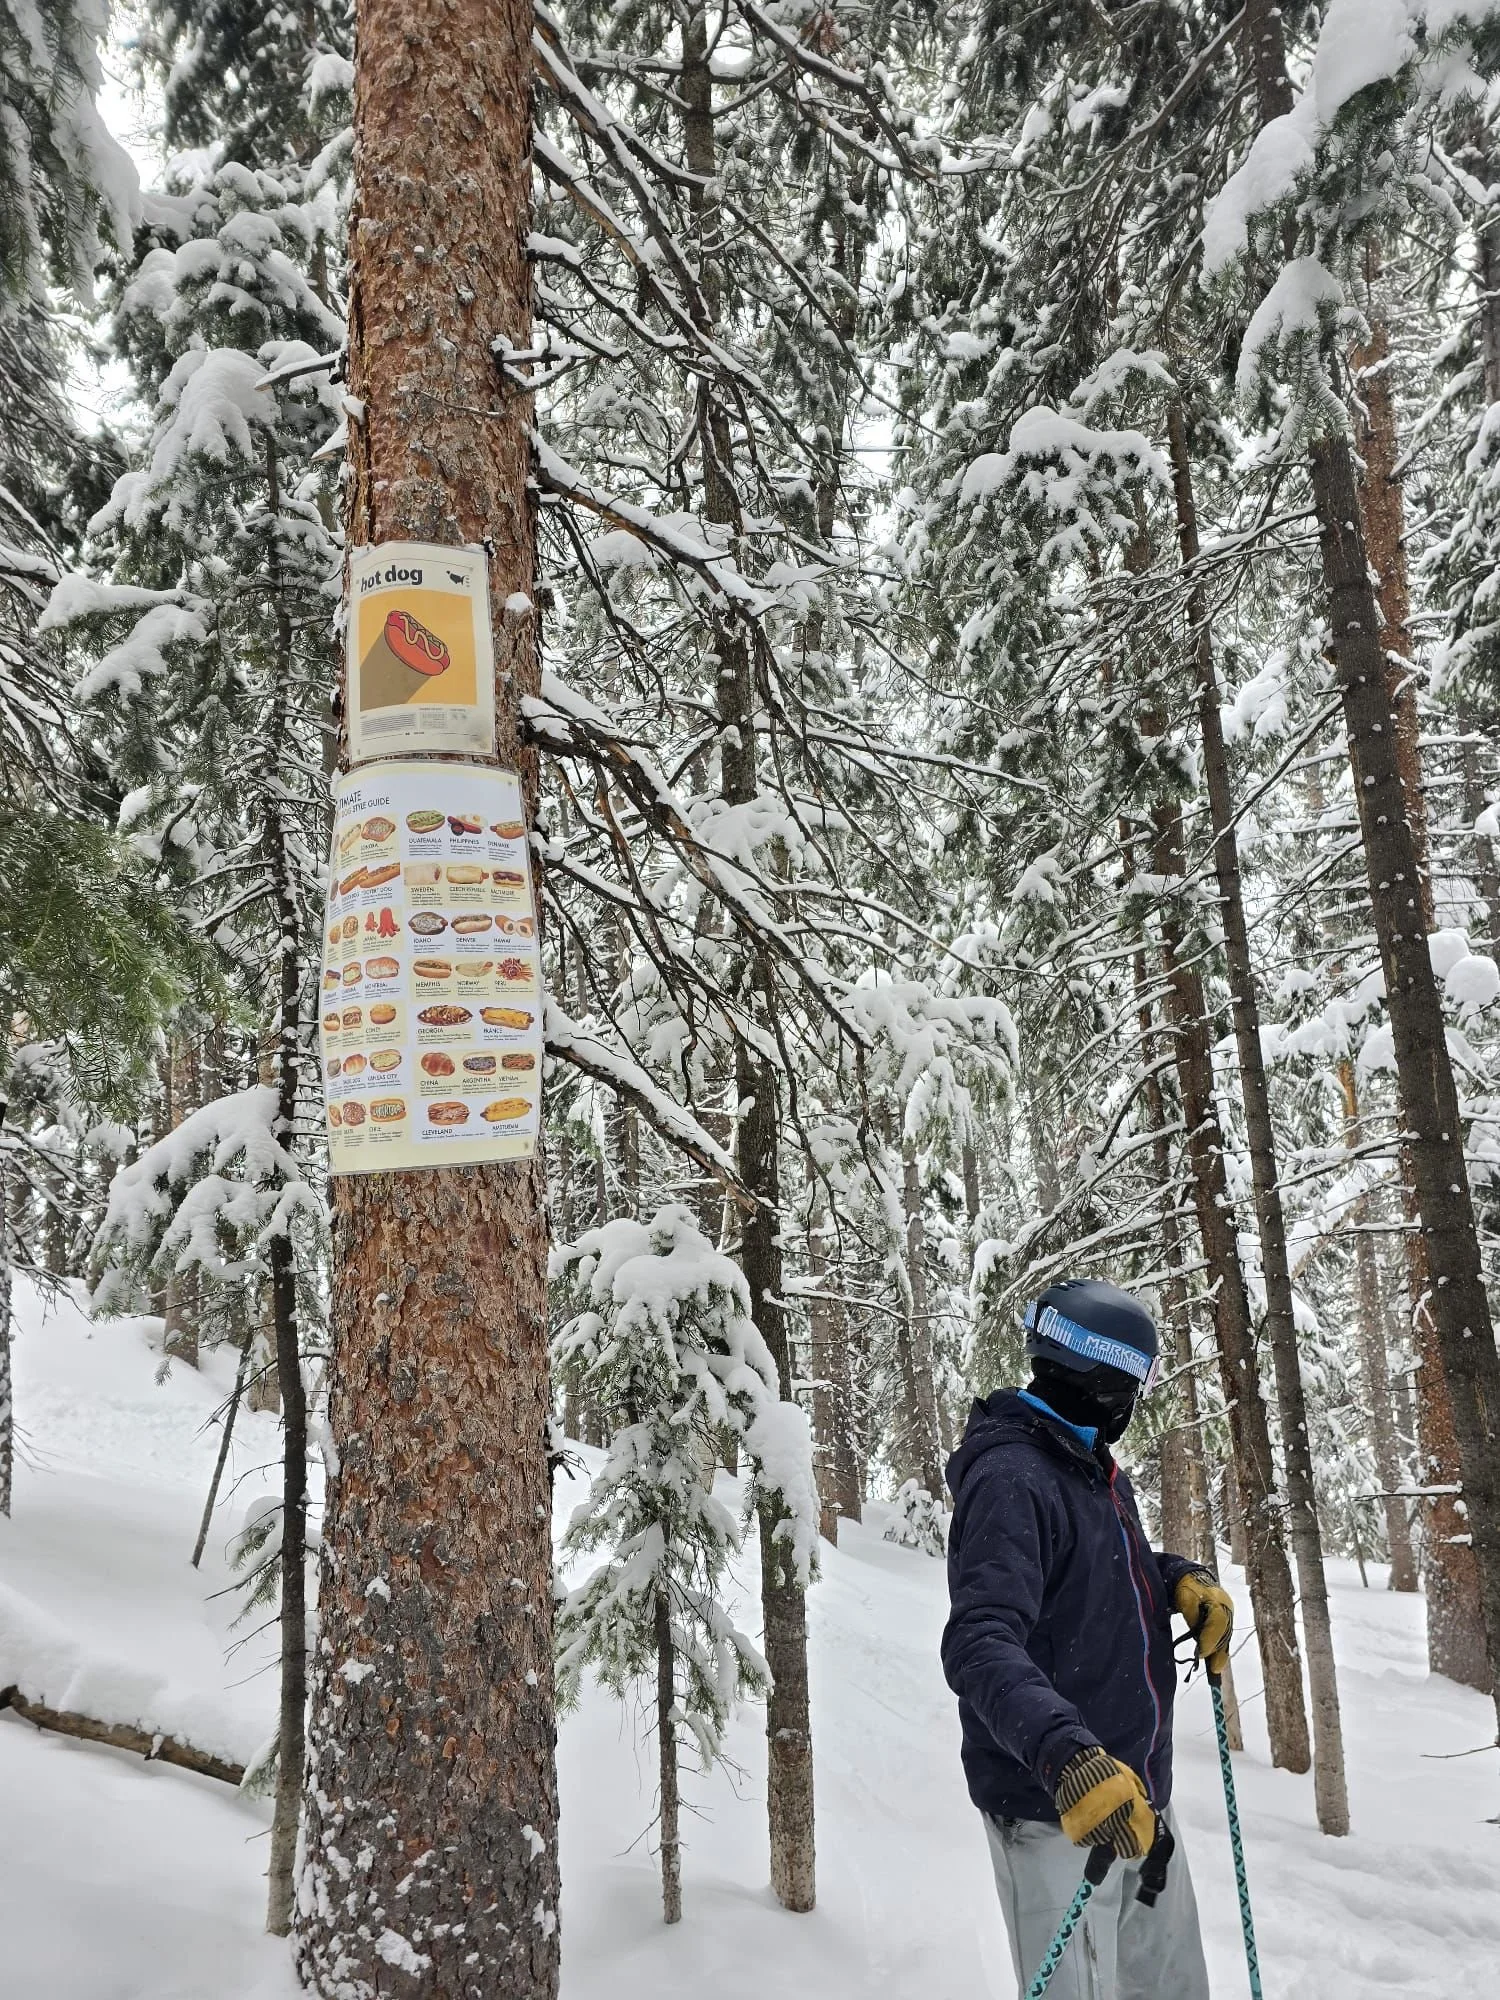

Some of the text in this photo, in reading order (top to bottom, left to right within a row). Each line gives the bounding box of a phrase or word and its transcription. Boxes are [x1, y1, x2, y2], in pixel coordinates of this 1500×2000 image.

[361, 570, 381, 592] hot
[385, 564, 422, 585] dog
[367, 797, 390, 808] GUIDE
[422, 1128, 453, 1136] CLEVELAND
